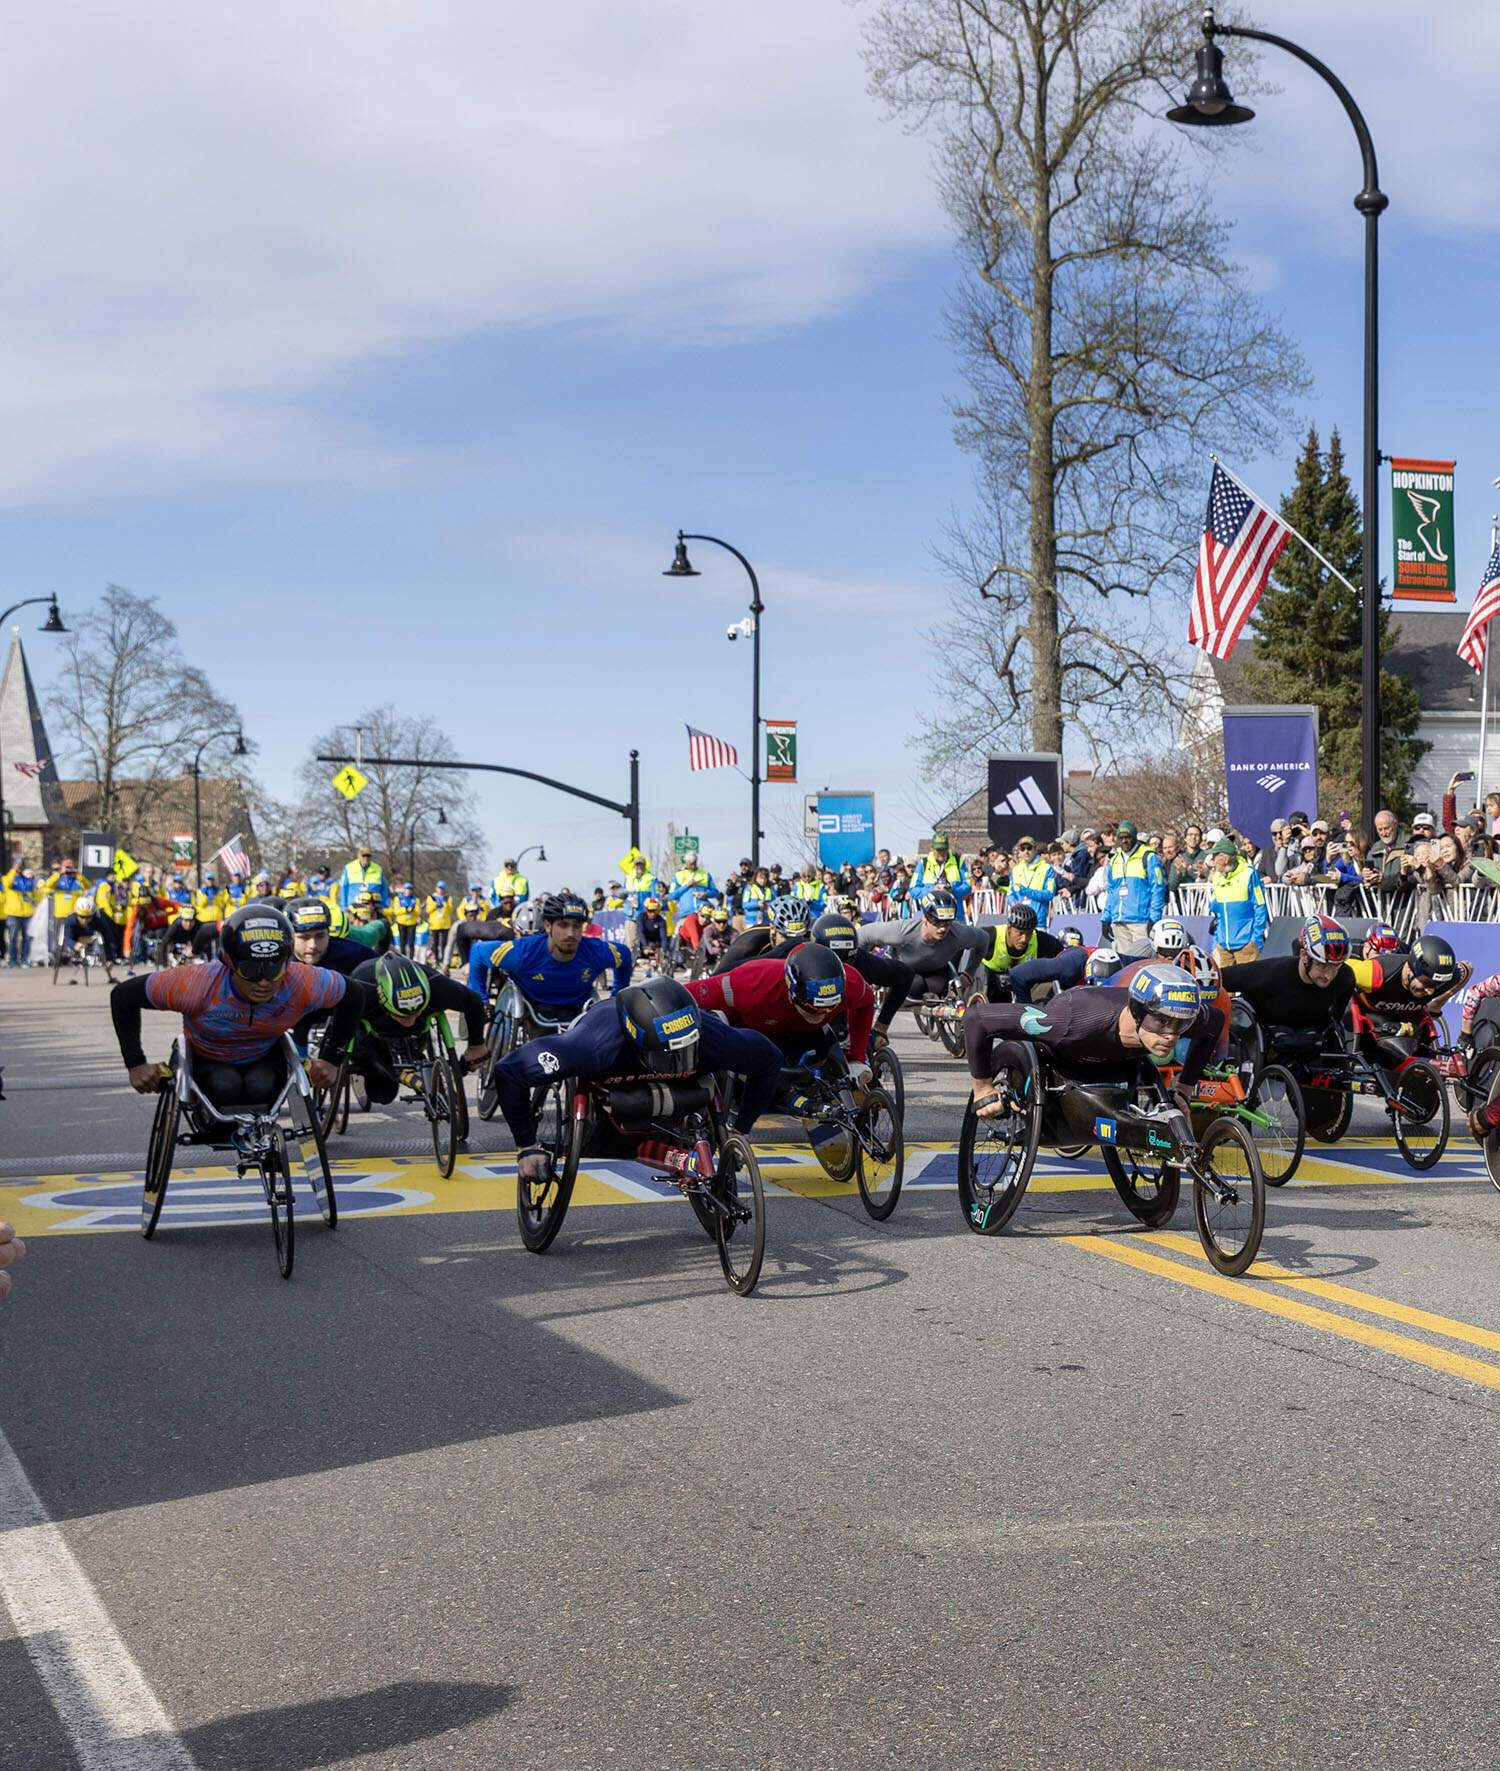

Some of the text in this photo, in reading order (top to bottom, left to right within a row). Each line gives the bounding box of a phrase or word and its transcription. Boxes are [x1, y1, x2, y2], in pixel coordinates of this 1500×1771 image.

[1393, 471, 1453, 491] HOPKINTON
[1397, 539, 1413, 550] The
[1398, 550, 1426, 561] Start of
[1398, 561, 1448, 576] SOMETHING
[1398, 574, 1448, 588] Extraordinary
[1230, 762, 1310, 772] BANK OF AMERICA
[241, 929, 285, 942] WATANABE
[818, 984, 836, 996] JOSH
[1136, 974, 1151, 993] W1
[1168, 990, 1196, 1003] MARCEL
[1375, 1001, 1423, 1011] ESPAÑA
[1101, 1123, 1111, 1138] W1
